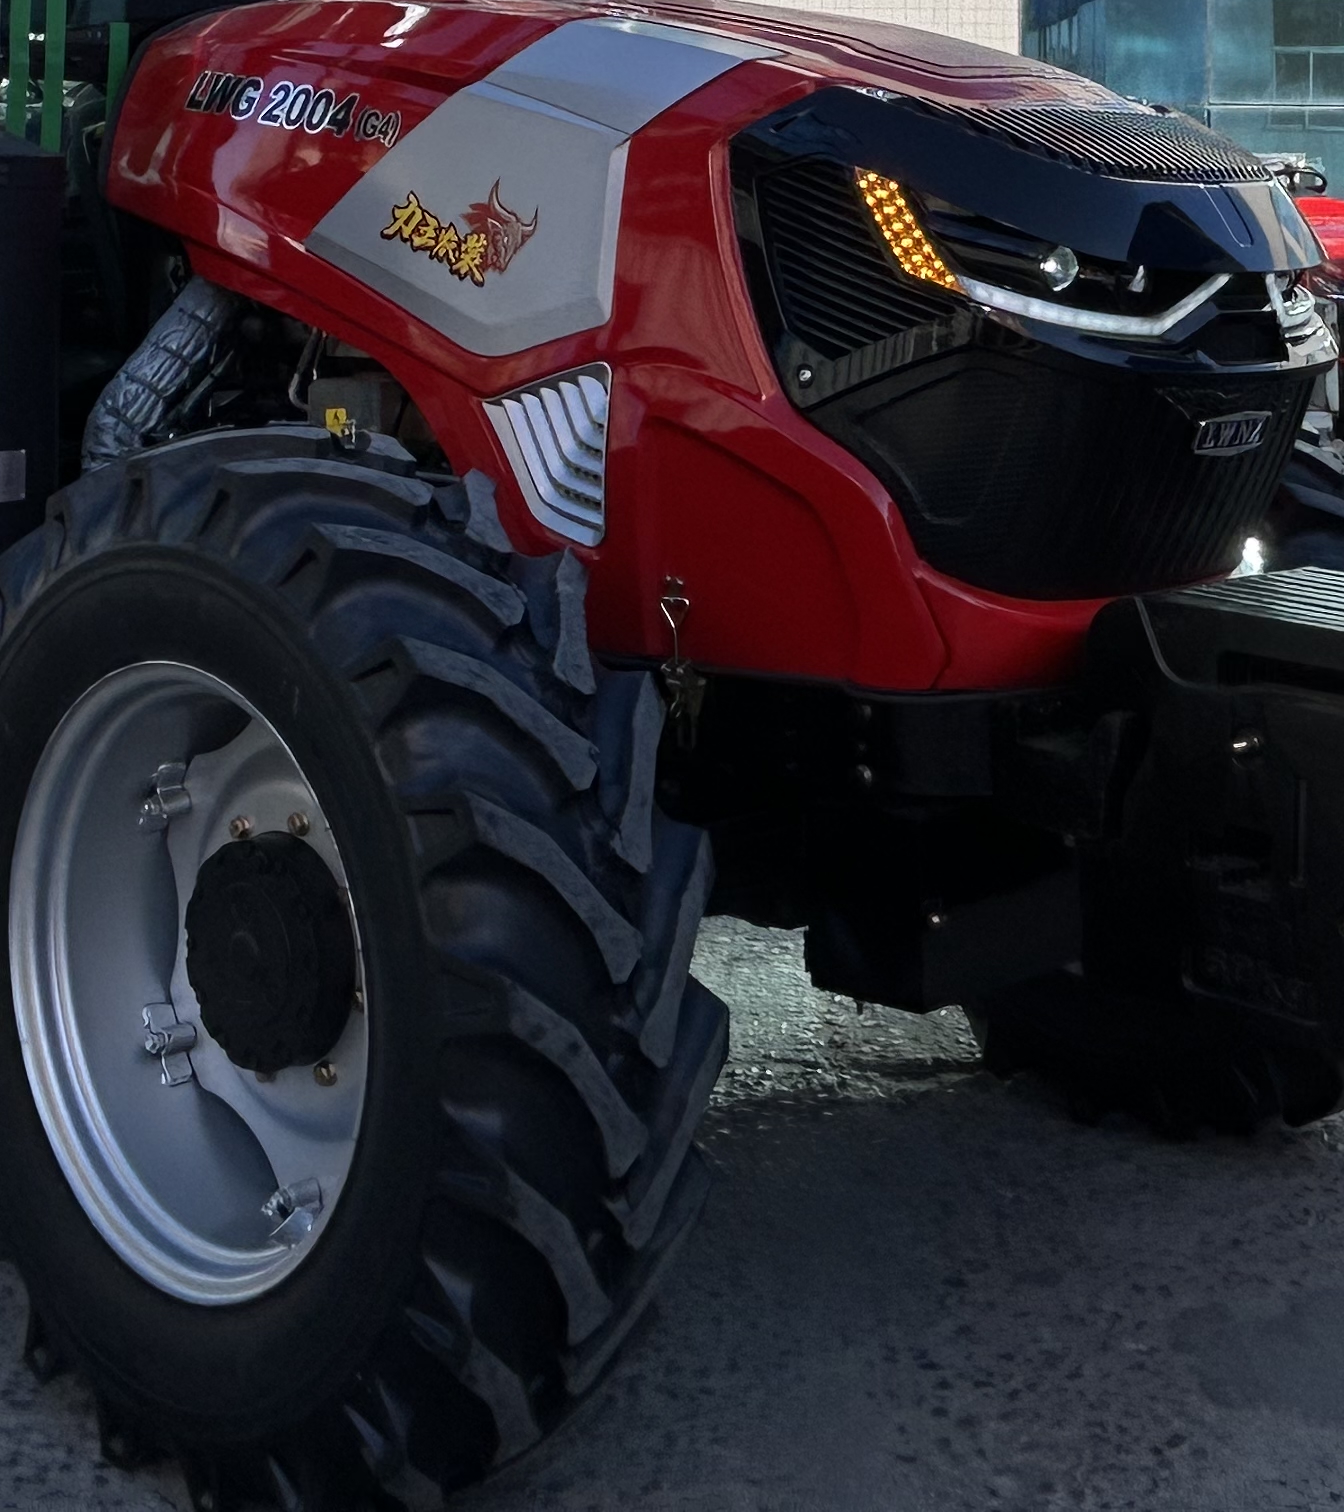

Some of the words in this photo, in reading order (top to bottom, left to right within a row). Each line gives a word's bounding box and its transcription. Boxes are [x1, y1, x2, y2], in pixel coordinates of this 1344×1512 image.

[185, 71, 264, 120] LWG
[258, 81, 360, 137] 2004
[356, 105, 401, 148] (G4)
